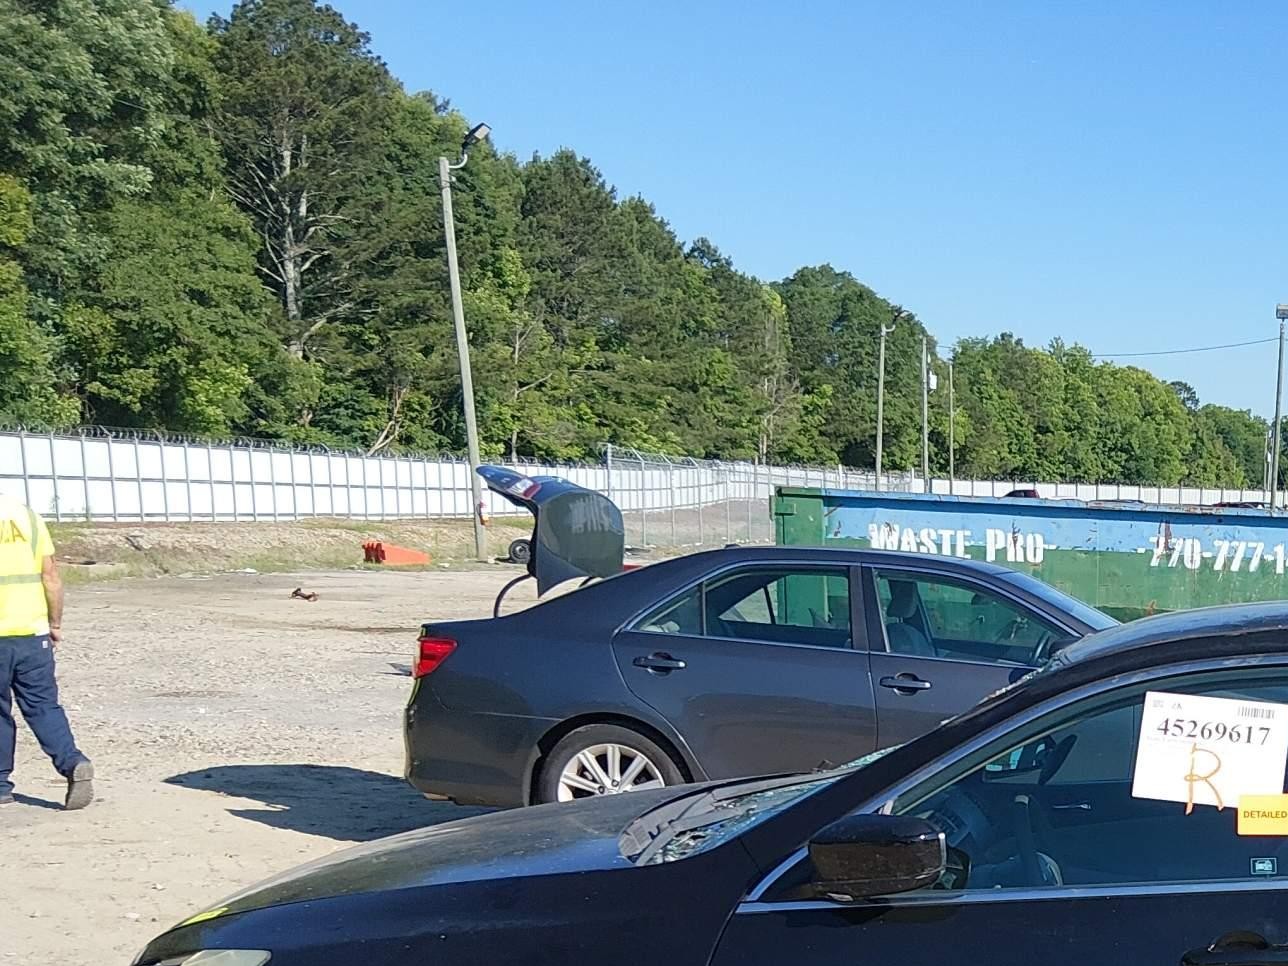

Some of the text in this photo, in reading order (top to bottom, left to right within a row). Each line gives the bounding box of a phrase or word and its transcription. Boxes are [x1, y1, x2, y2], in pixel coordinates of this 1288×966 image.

[868, 523, 973, 560] WASTE
[985, 528, 1044, 564] PRO
[1156, 716, 1271, 746] 45269617
[1243, 810, 1288, 819] DETAILED
